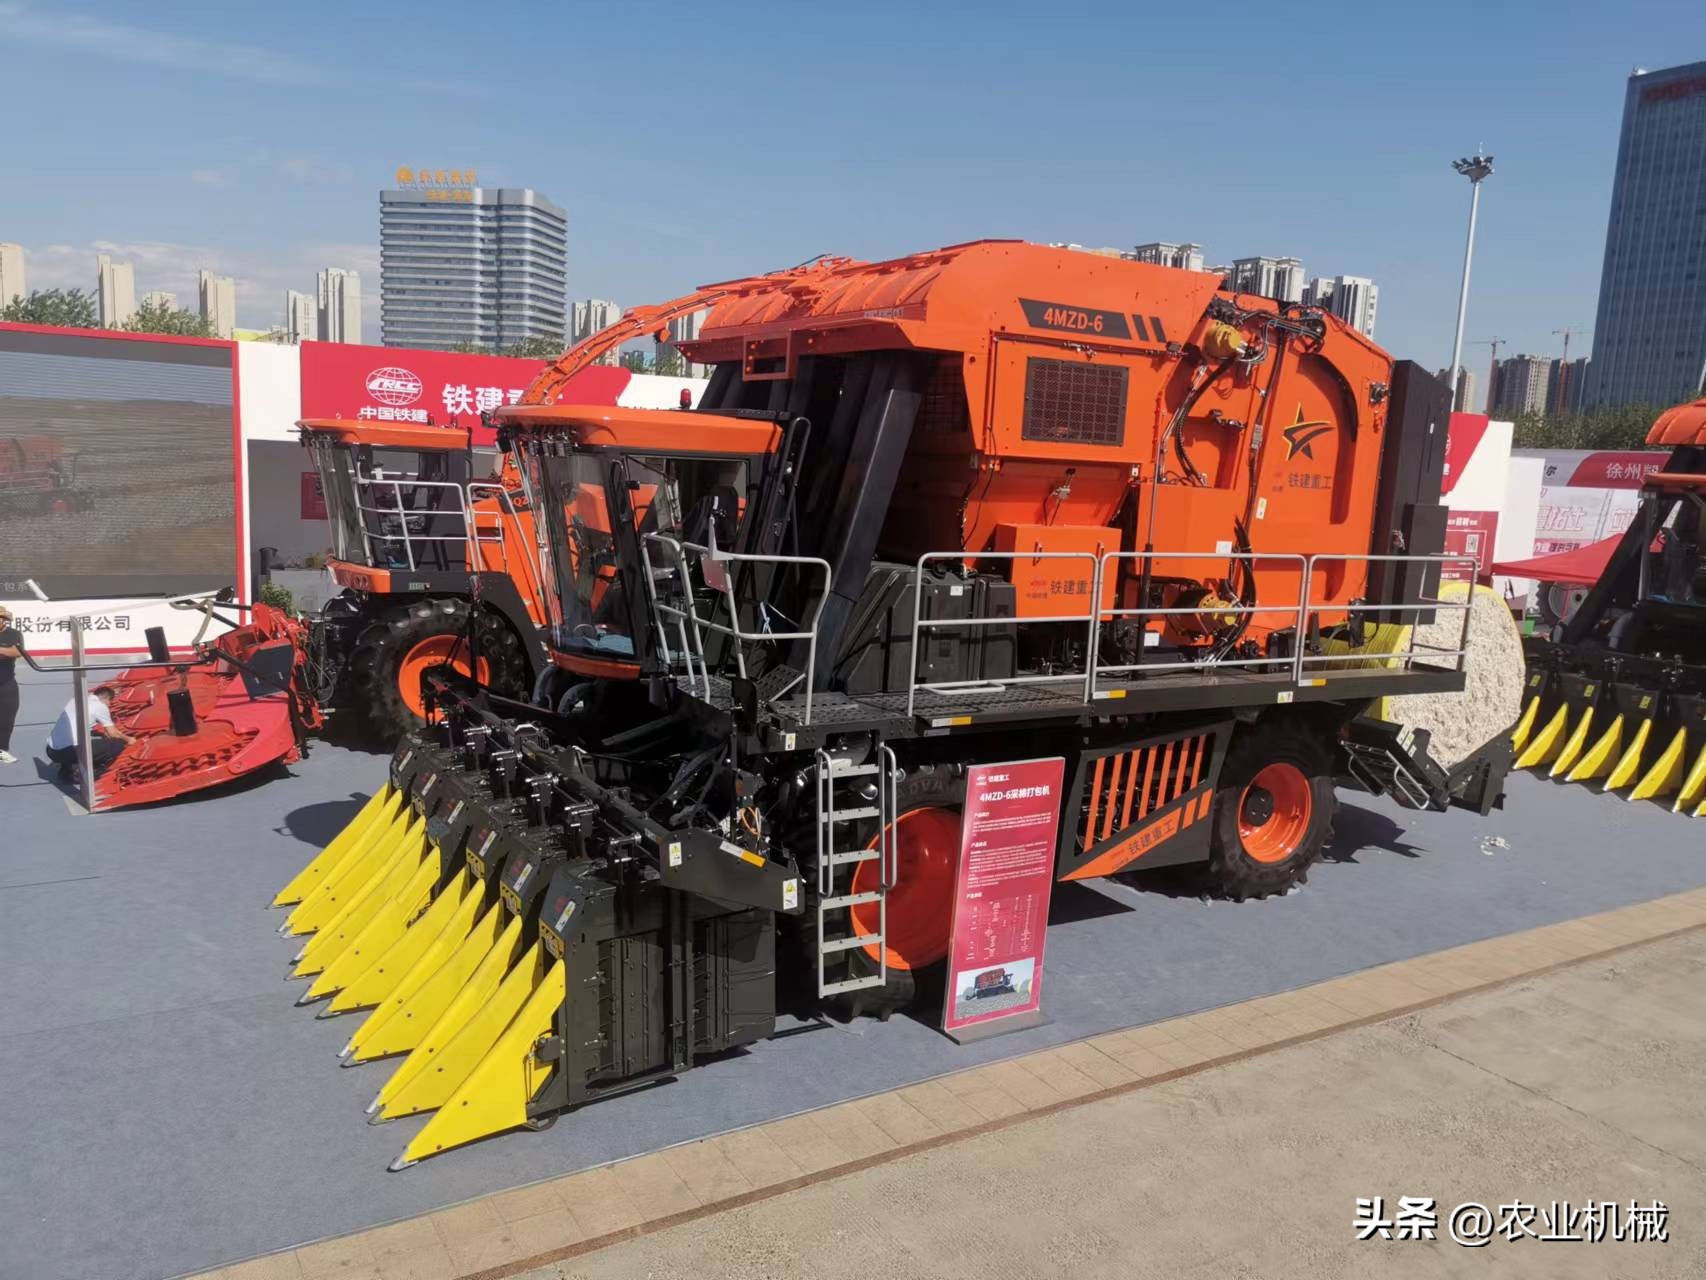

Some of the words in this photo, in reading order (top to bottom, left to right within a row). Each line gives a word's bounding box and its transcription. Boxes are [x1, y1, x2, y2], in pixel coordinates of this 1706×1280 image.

[1043, 308, 1103, 332] 4MZD-6
[360, 406, 428, 423] 中国铁建
[1050, 579, 1096, 595] 铁建重
[5, 616, 131, 633] 股份有限公司
